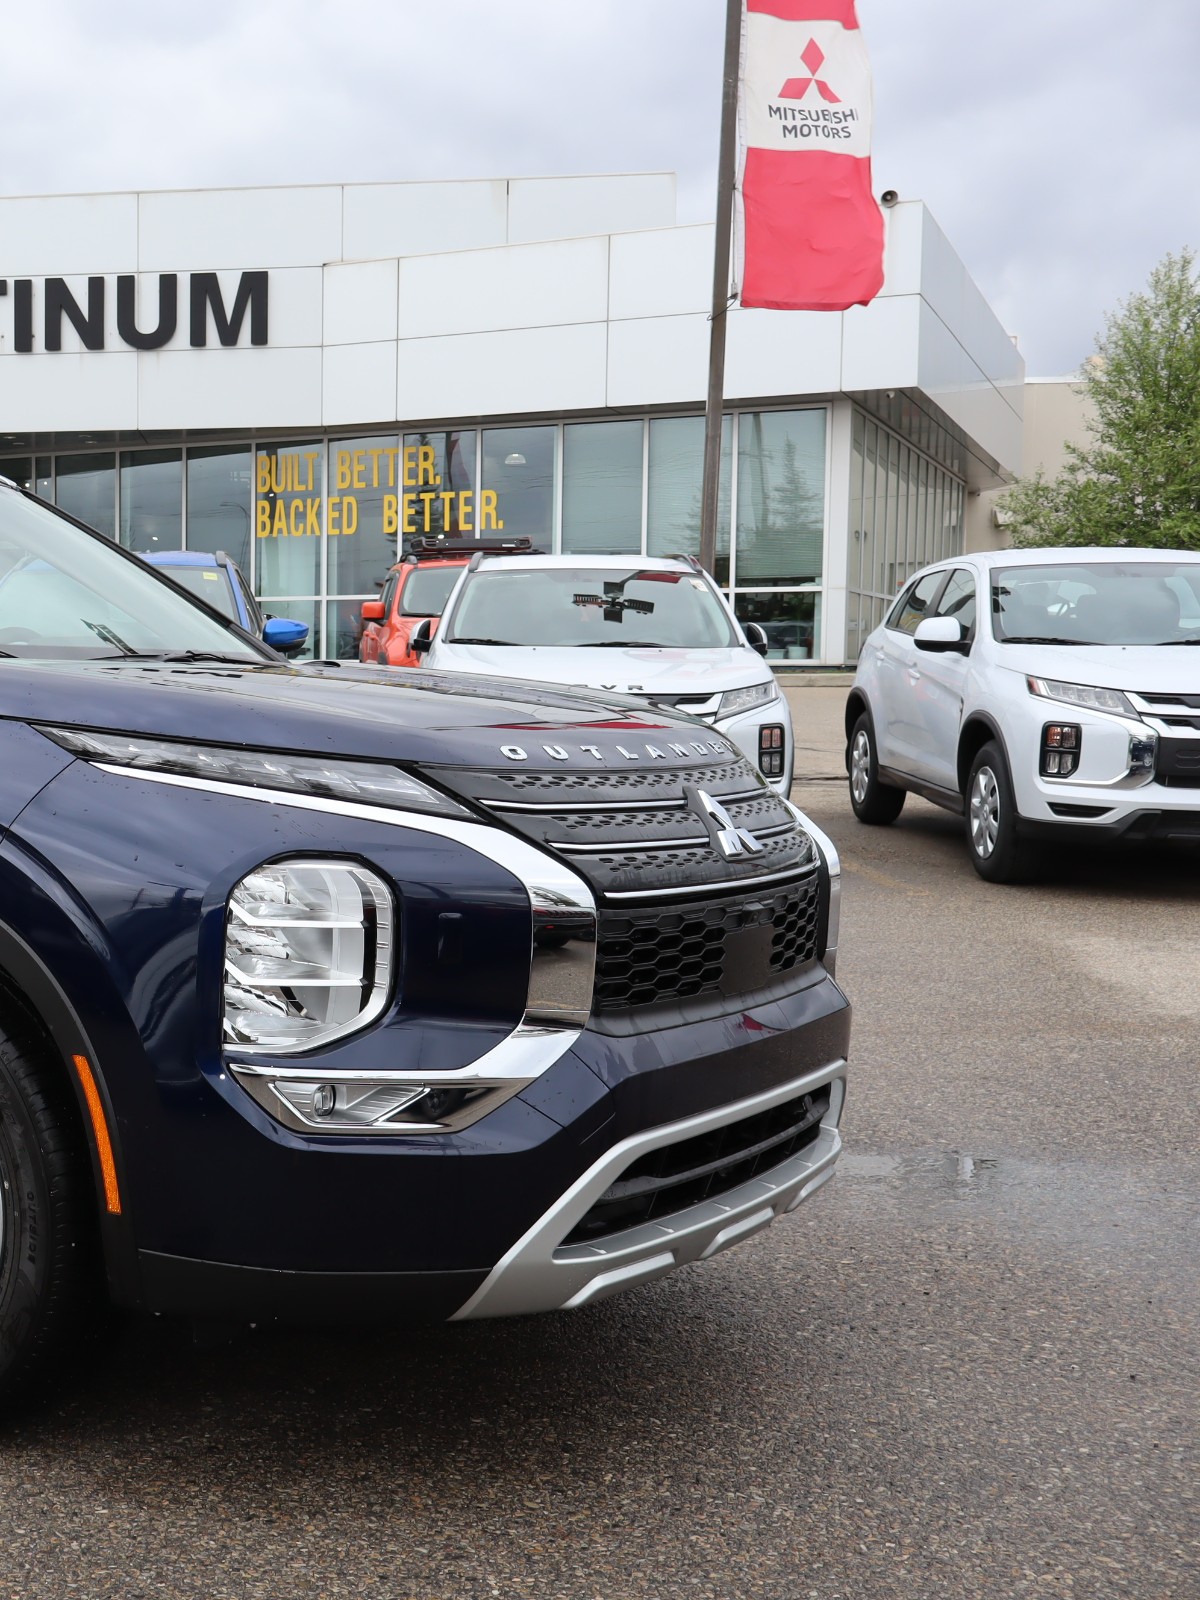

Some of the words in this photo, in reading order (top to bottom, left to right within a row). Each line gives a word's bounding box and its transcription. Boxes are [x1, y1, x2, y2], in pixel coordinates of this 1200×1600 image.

[782, 124, 852, 139] MOTORS
[256, 452, 320, 494] BUILT
[336, 445, 441, 490] BETTER.
[256, 495, 358, 539] BACKED
[383, 488, 504, 534] BETTER.
[572, 683, 645, 691] VR
[26, 1190, 40, 1265] OUTSIDE
